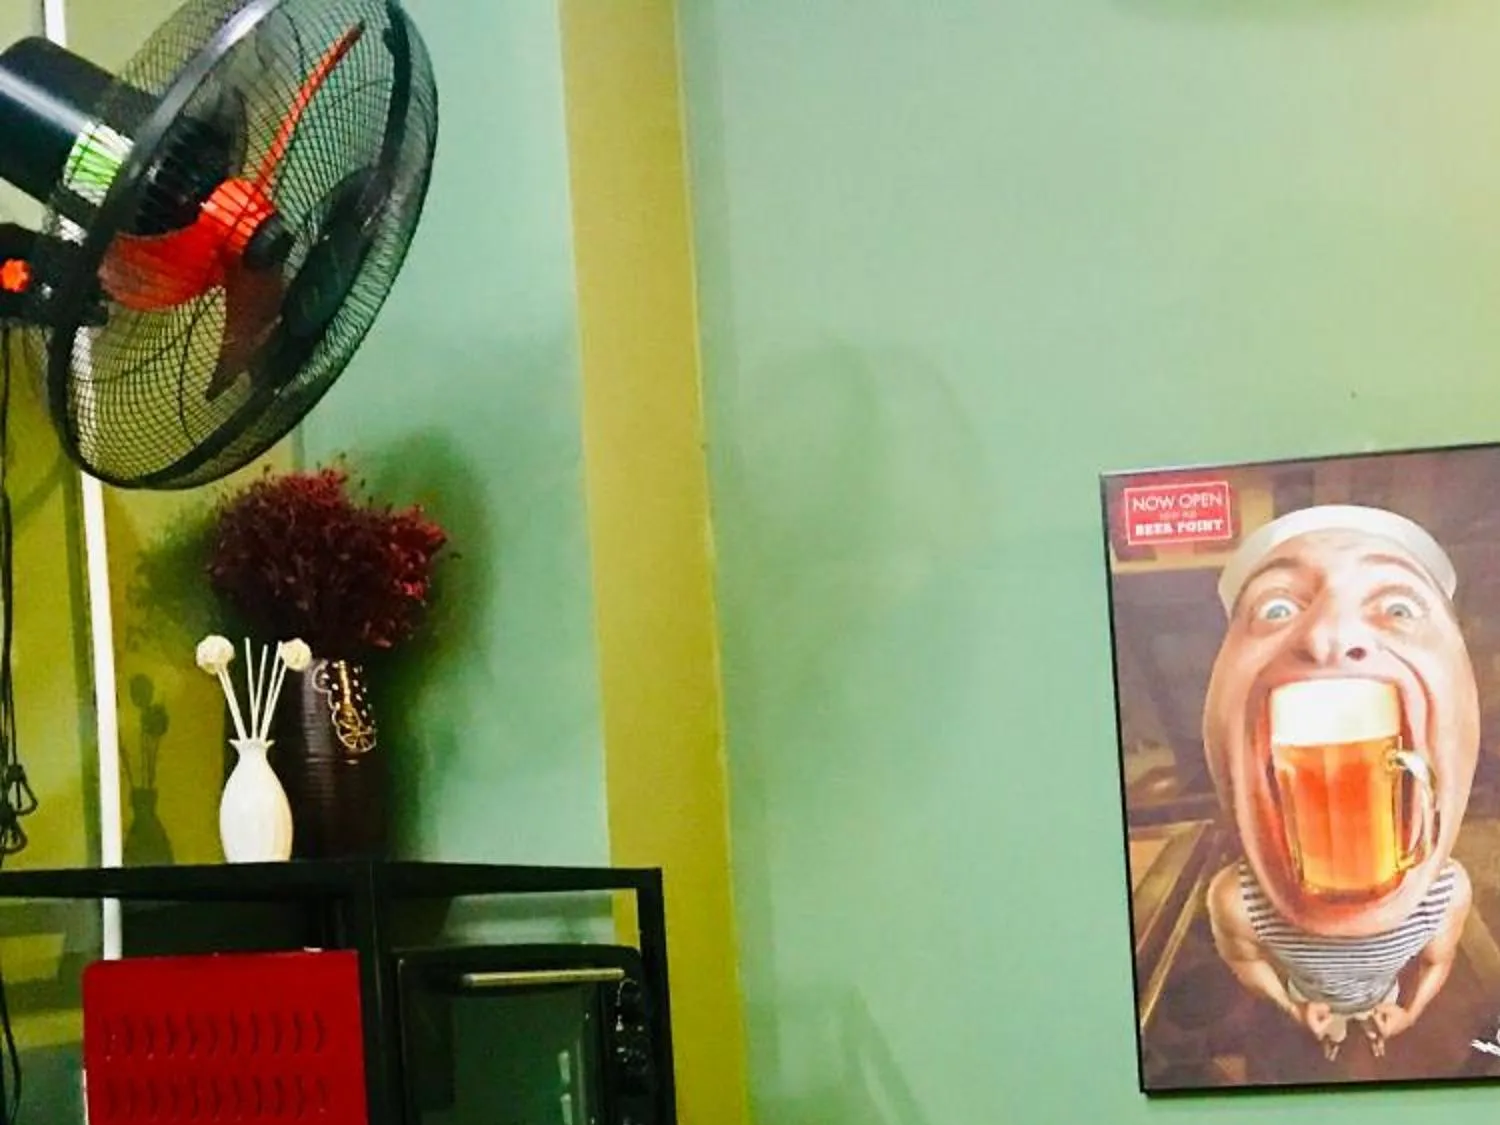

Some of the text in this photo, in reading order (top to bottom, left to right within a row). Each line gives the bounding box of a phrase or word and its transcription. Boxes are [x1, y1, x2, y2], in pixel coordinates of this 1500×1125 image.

[1132, 493, 1222, 512] NOW OPEN
[1178, 519, 1223, 532] POINT
